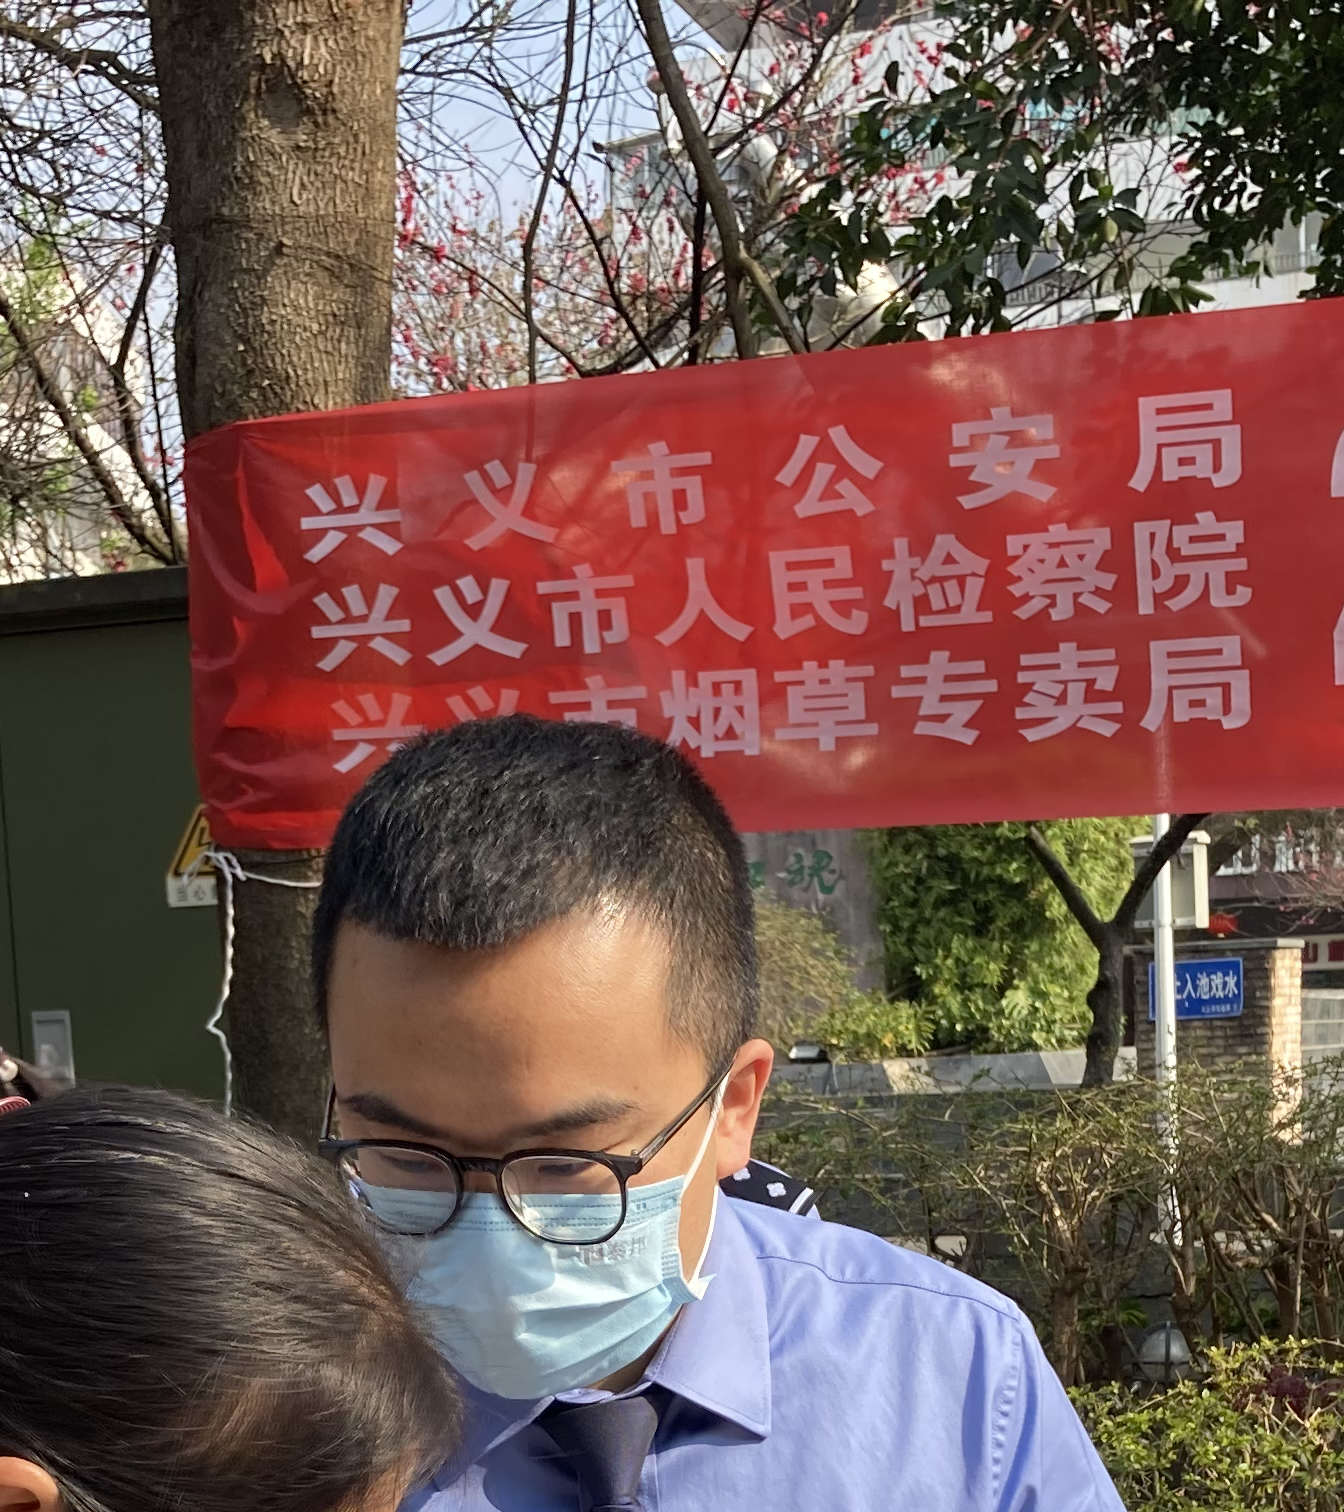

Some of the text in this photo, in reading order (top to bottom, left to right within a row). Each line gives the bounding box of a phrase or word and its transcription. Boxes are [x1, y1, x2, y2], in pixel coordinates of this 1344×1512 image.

[300, 388, 1242, 564] 兴义市公安局
[310, 510, 1253, 672] 兴义市人民检察院
